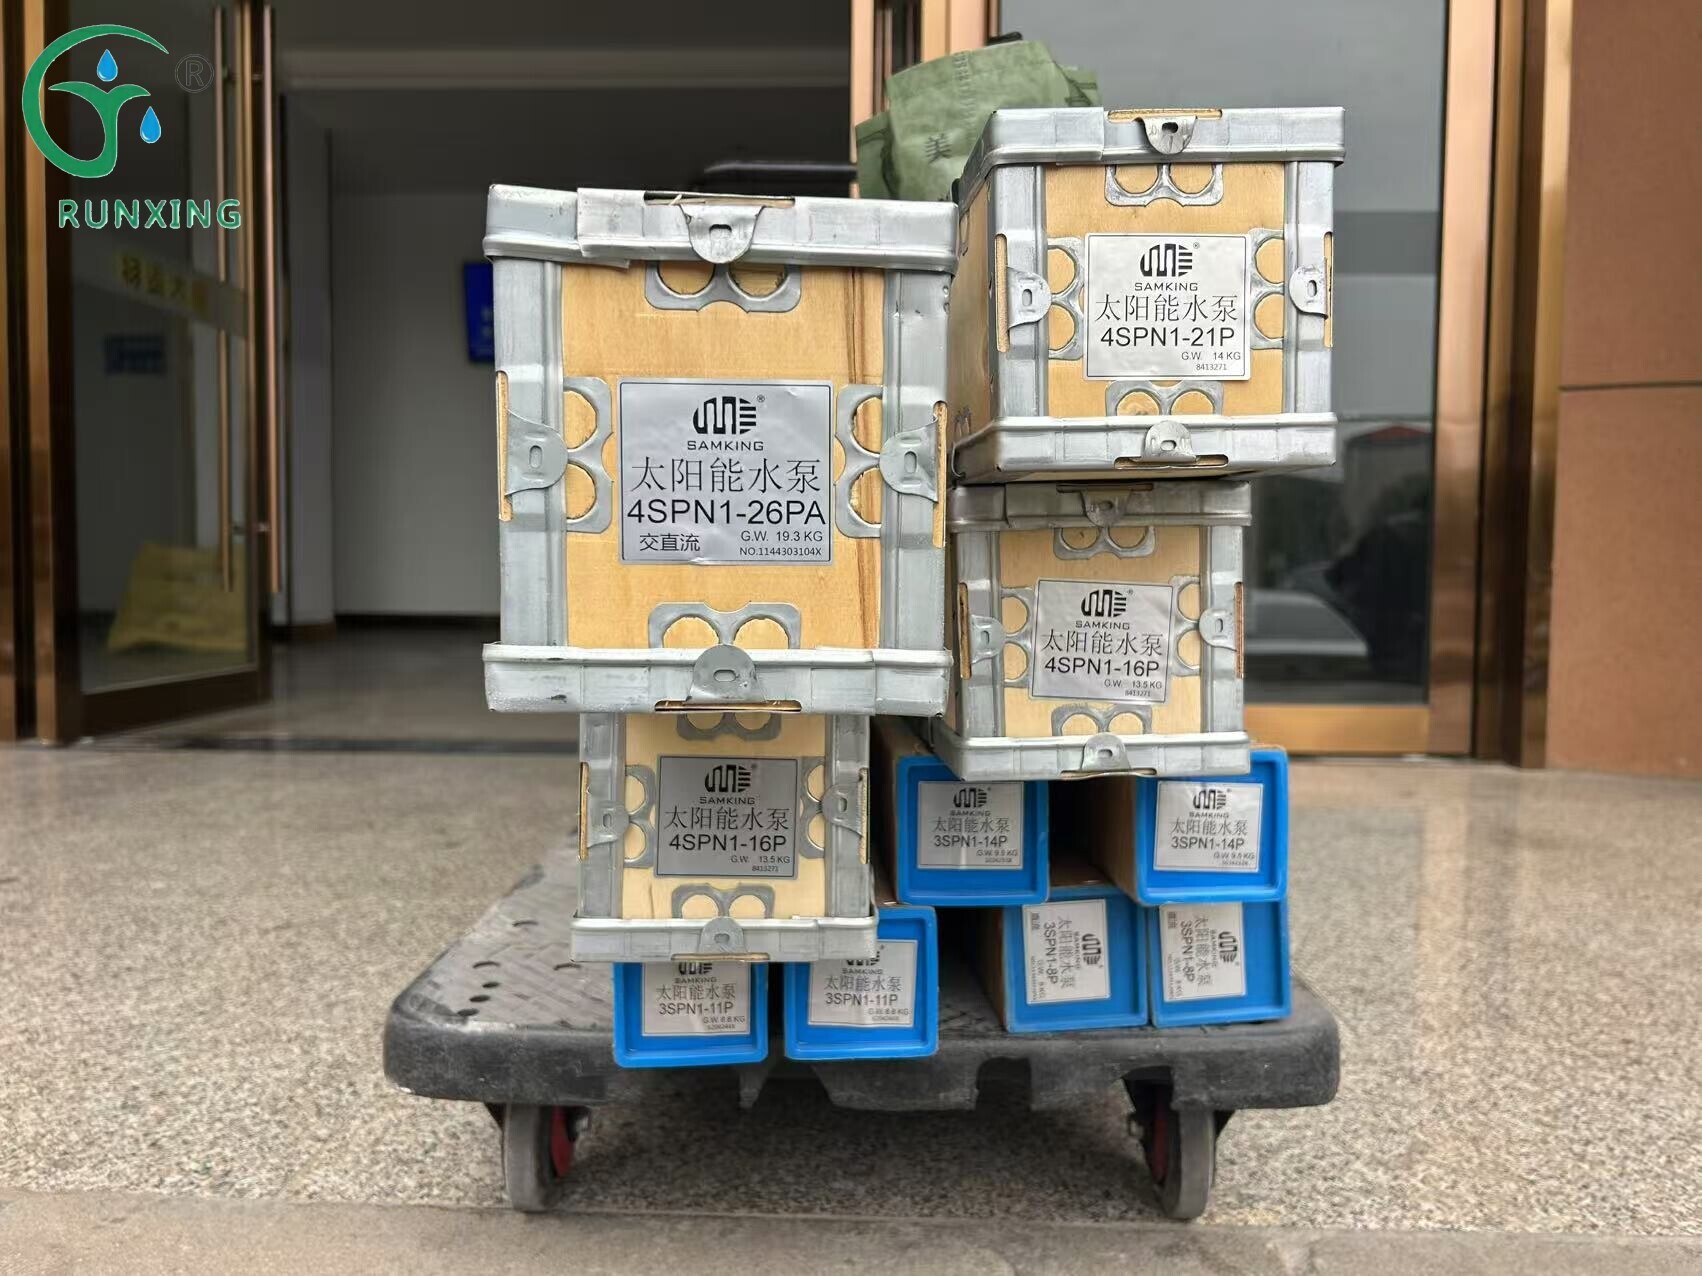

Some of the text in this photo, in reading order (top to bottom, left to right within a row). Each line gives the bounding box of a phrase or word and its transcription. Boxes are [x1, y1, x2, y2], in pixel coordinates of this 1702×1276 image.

[1134, 283, 1198, 291] SAMKING
[1095, 294, 1237, 322] 太阳能水泵
[1101, 327, 1234, 346] 4SPN1-21P
[1213, 352, 1223, 360] 14
[1226, 352, 1241, 360] KG
[687, 440, 764, 451] SAMKING
[631, 456, 820, 493] 太阳能水泵
[627, 499, 826, 525] 4SPN1-26PA
[640, 534, 700, 551] 交直流
[741, 531, 823, 542] G.W. 19.3 KG
[1075, 621, 1130, 630] SAMKING
[1041, 629, 1163, 656] 太阳能水泵
[1045, 657, 1159, 677] 4SPN1-16P
[664, 806, 790, 830] 太阳能水泵
[931, 817, 1010, 833] 太阳能水泵
[1170, 818, 1248, 836] 太阳能水泵
[669, 834, 786, 851] 4SPN1-16P
[934, 835, 1007, 847] 3SPN1-14P
[1171, 836, 1245, 850] 3SPN1-14P
[1043, 922, 1059, 984] 3SPN1-8P
[1181, 920, 1195, 982] 3SPN1-8P
[656, 983, 736, 1001] 太阳能水泵
[824, 975, 902, 992] 太阳能水泵
[825, 993, 898, 1006] 3SPN1-11P
[659, 1002, 734, 1016] 3SPN1-11P
